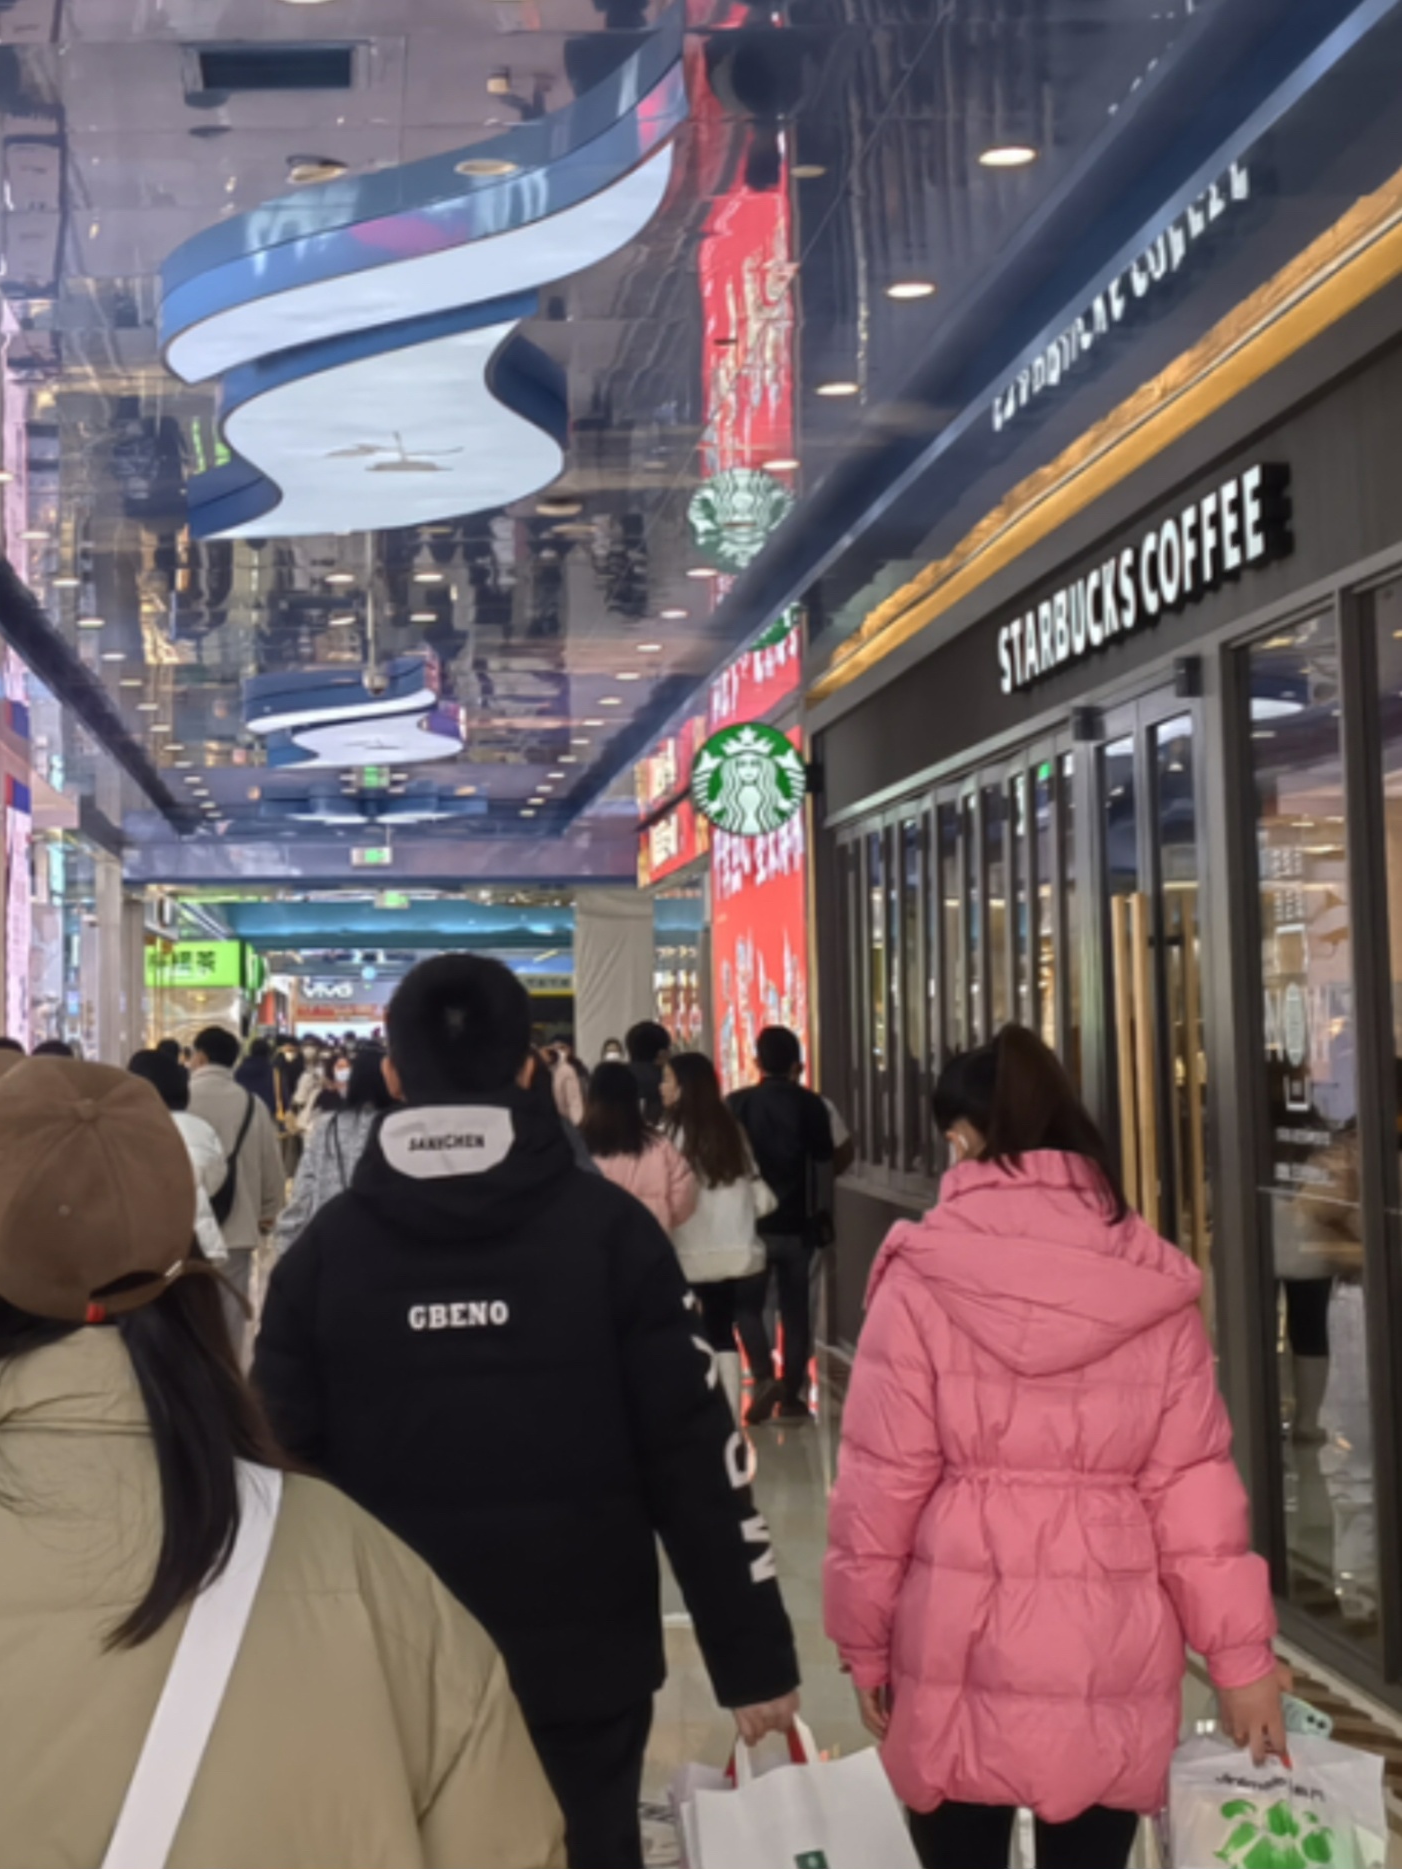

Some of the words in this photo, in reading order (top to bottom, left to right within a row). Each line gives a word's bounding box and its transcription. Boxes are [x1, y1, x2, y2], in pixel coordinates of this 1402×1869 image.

[998, 547, 1136, 694] STARBUCKS
[1140, 464, 1265, 615] COFFEE
[407, 1299, 509, 1331] GBENO
